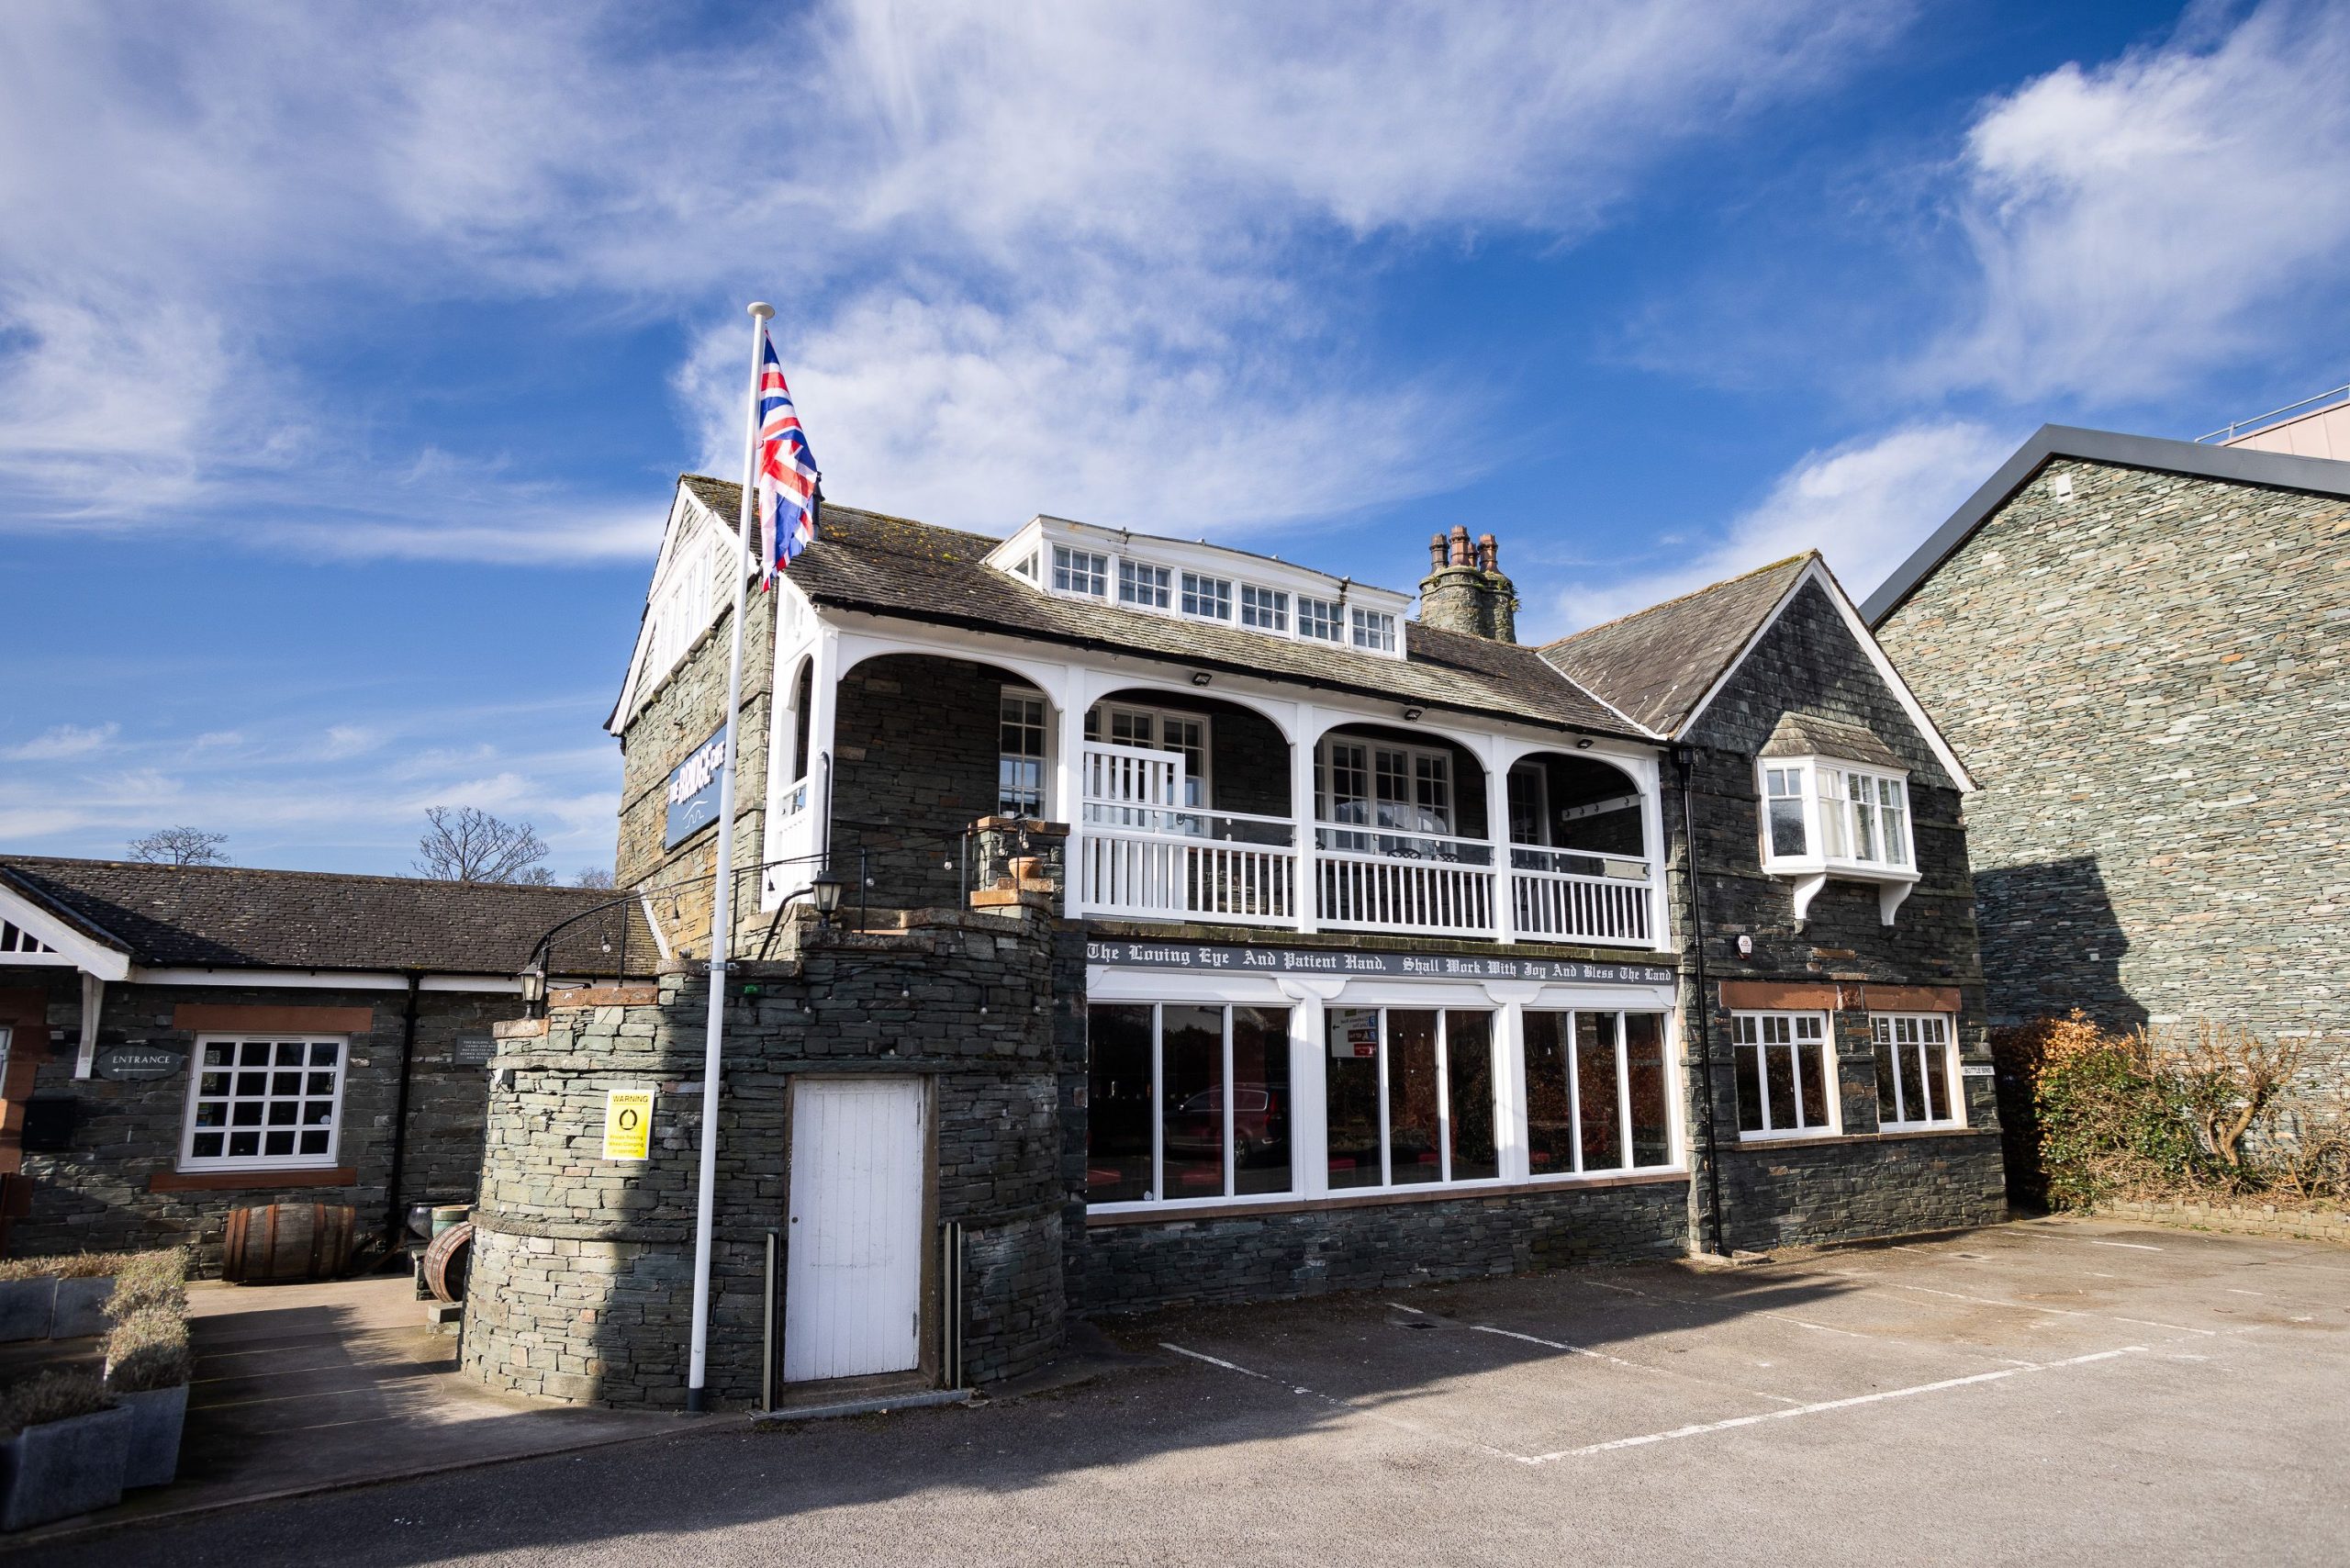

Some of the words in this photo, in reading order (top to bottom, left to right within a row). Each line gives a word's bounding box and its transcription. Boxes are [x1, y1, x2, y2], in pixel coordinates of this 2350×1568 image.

[1087, 942, 1120, 963] The
[1128, 945, 1192, 965] Loving
[1198, 947, 1229, 967] Eye
[1242, 949, 1276, 966] And
[1283, 951, 1337, 969] Patient
[1402, 957, 1439, 975] Shall
[1446, 958, 1482, 974] Work
[1487, 959, 1516, 977] With
[1524, 962, 1546, 980] Joy
[1551, 962, 1577, 978] And
[1583, 965, 1614, 980] Bless
[1619, 967, 1639, 982] The
[1644, 967, 1672, 981] Land
[112, 1056, 171, 1064] ENTRANCE
